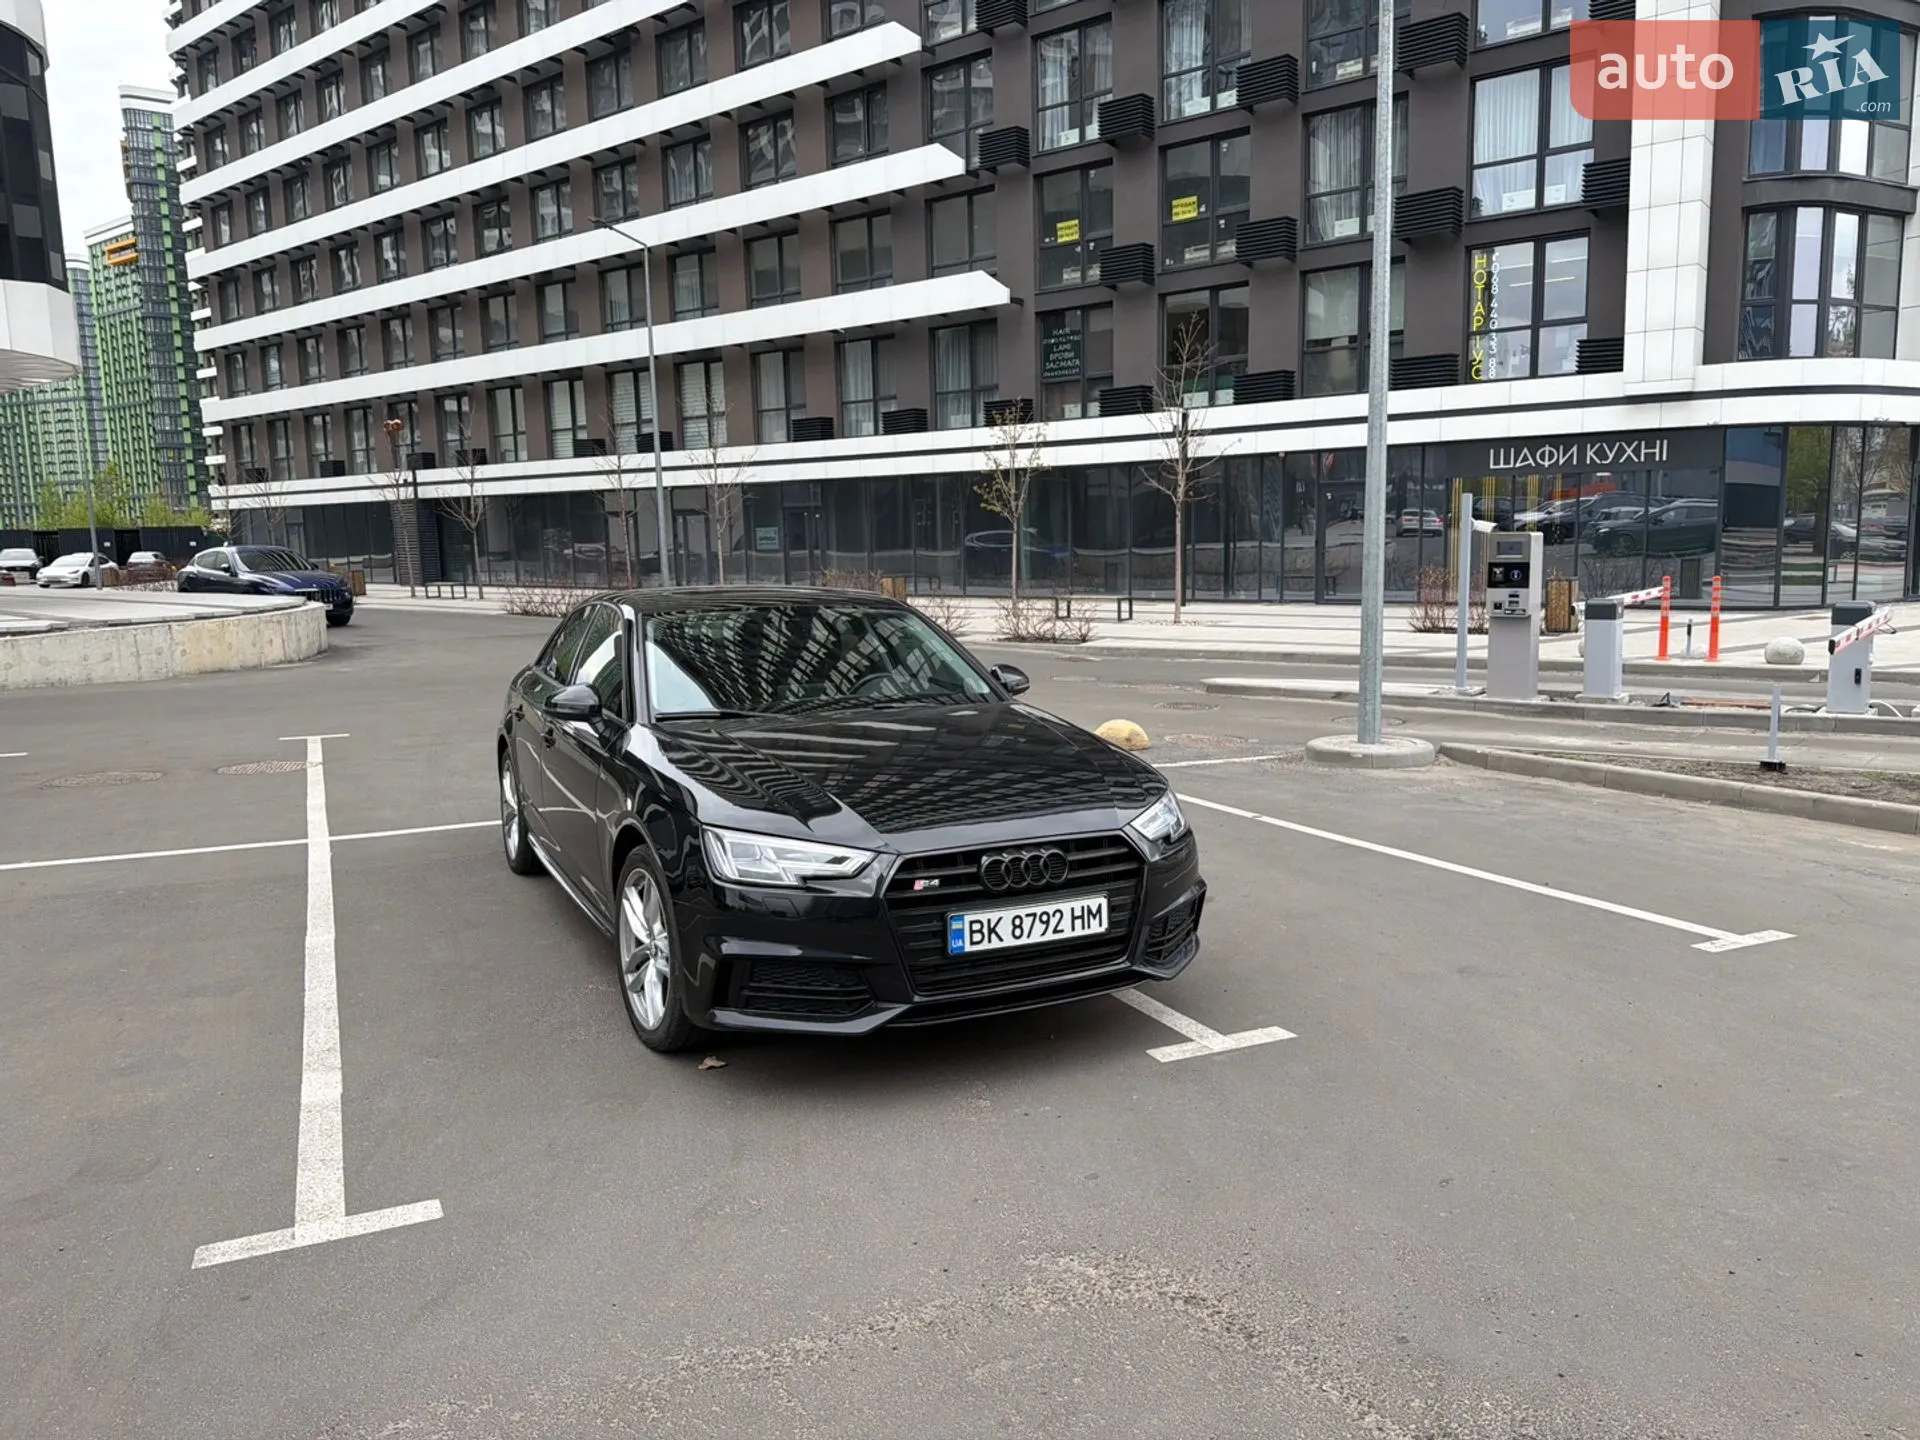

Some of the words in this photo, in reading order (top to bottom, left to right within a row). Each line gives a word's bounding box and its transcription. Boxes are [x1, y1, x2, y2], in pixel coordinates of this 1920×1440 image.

[1471, 253, 1487, 381] НОТАРІУС
[1489, 443, 1578, 469] ШАФИ
[1586, 439, 1668, 465] КУХНІ
[968, 916, 1004, 946] BK
[1011, 909, 1065, 940] 8792
[1071, 902, 1103, 933] HM
[951, 939, 964, 948] UA
